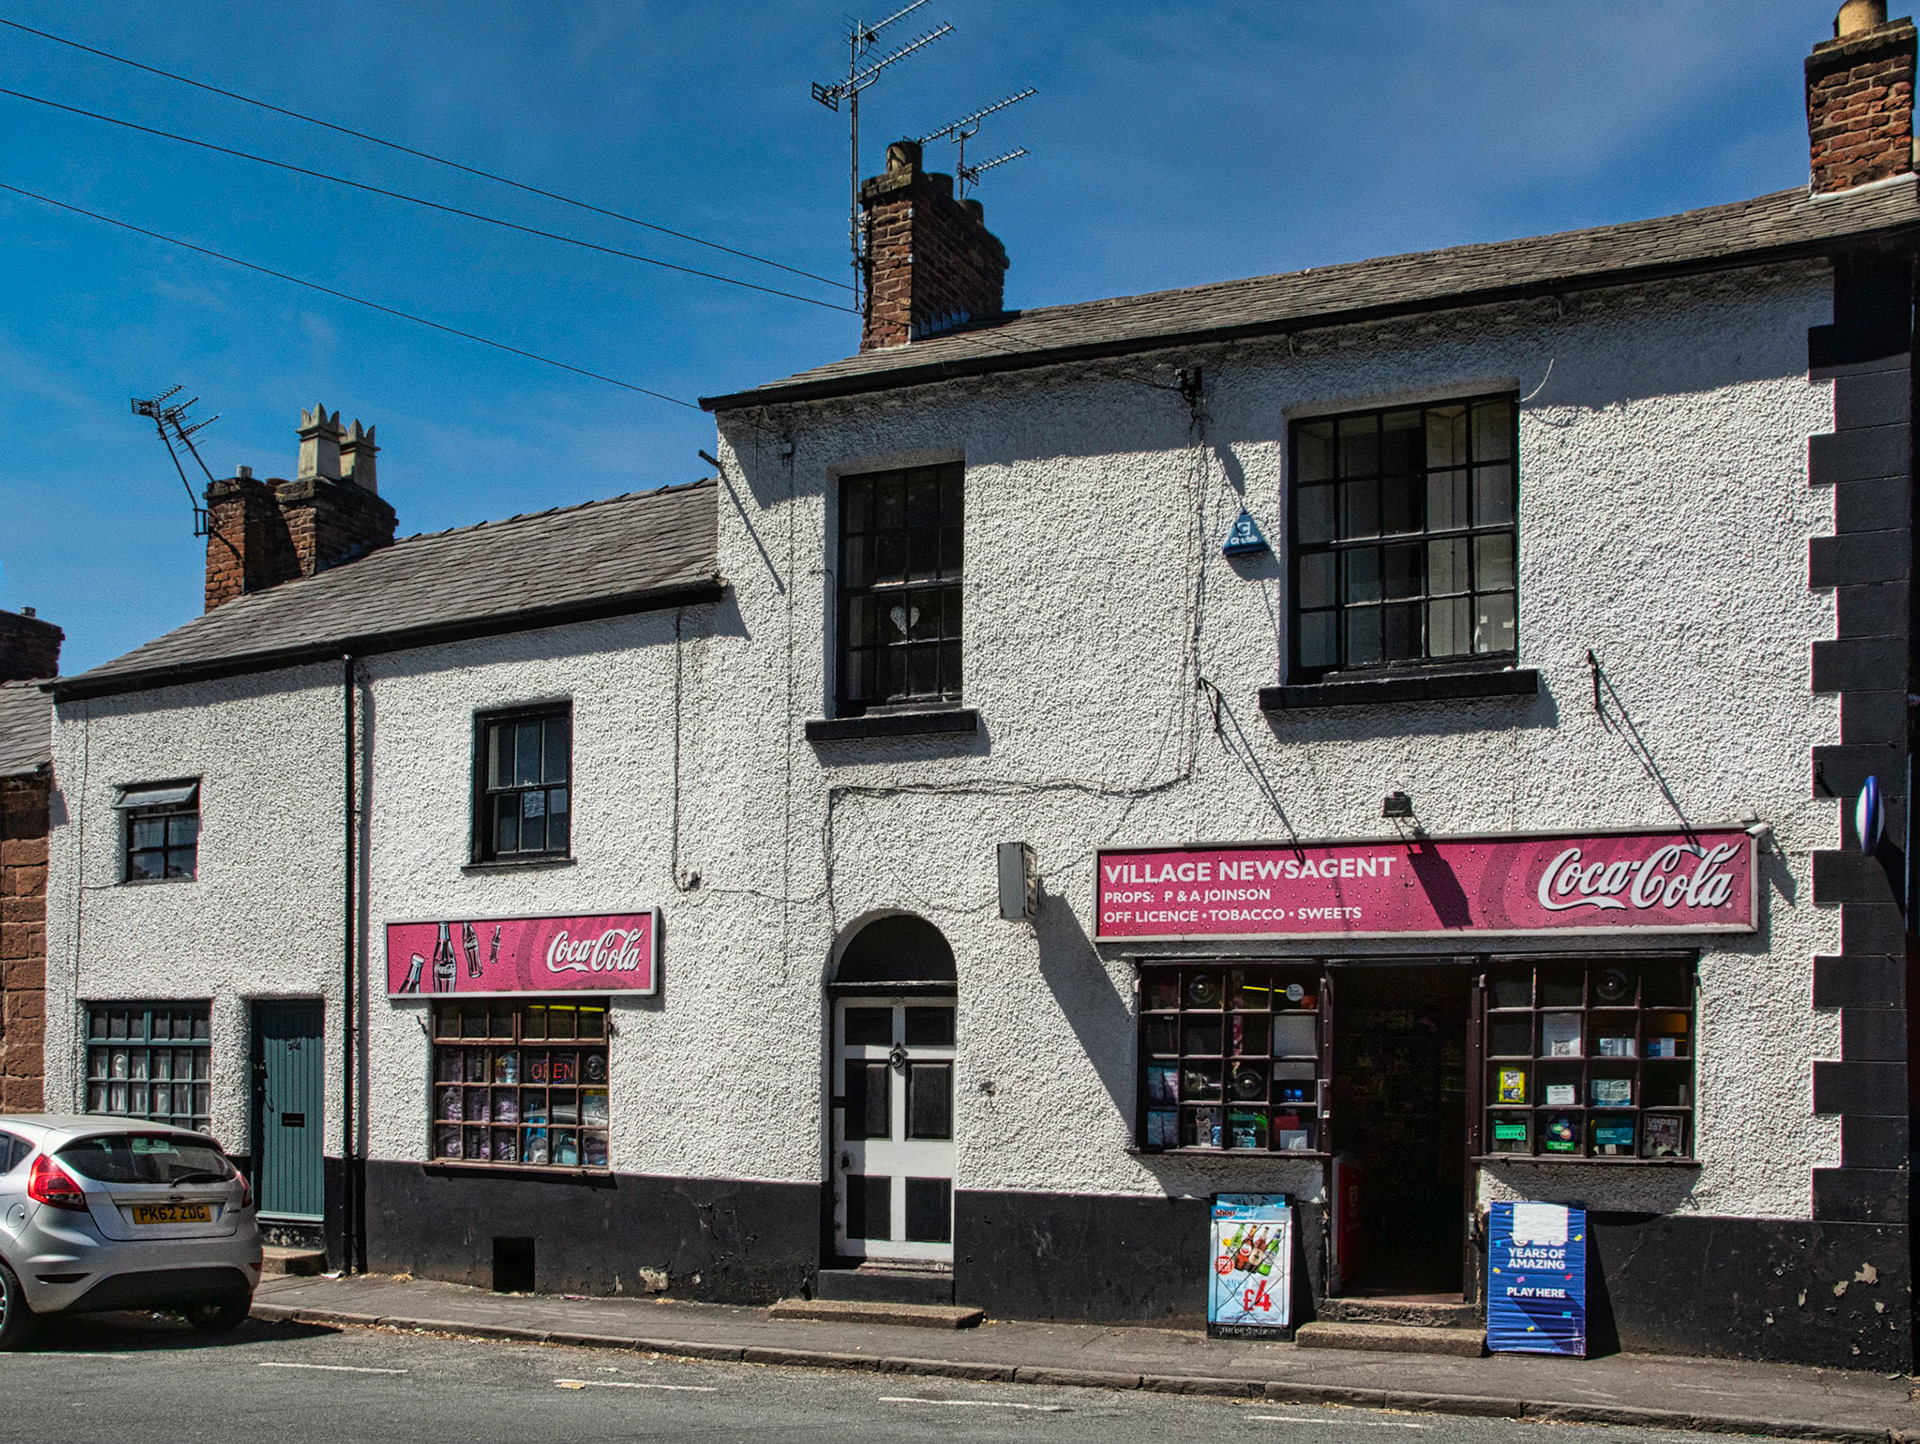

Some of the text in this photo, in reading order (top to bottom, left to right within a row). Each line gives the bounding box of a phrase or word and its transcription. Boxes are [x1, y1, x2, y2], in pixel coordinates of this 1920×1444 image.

[1104, 856, 1397, 884] VILLAGE NEWSAGENT
[1537, 842, 1744, 911] Coca-Cola
[1104, 889, 1271, 904] PROPS: P & A JOINSON
[1103, 907, 1362, 923] OFF LICENCE TOBACCO SWEETS
[546, 928, 644, 974] Coca-Cola
[139, 1206, 206, 1221] PK62 ZDG
[1508, 1248, 1566, 1259] YEARS OF
[1507, 1258, 1566, 1270] AMAZING
[1243, 1279, 1272, 1312] £4
[1506, 1286, 1566, 1298] PLAY HERE
